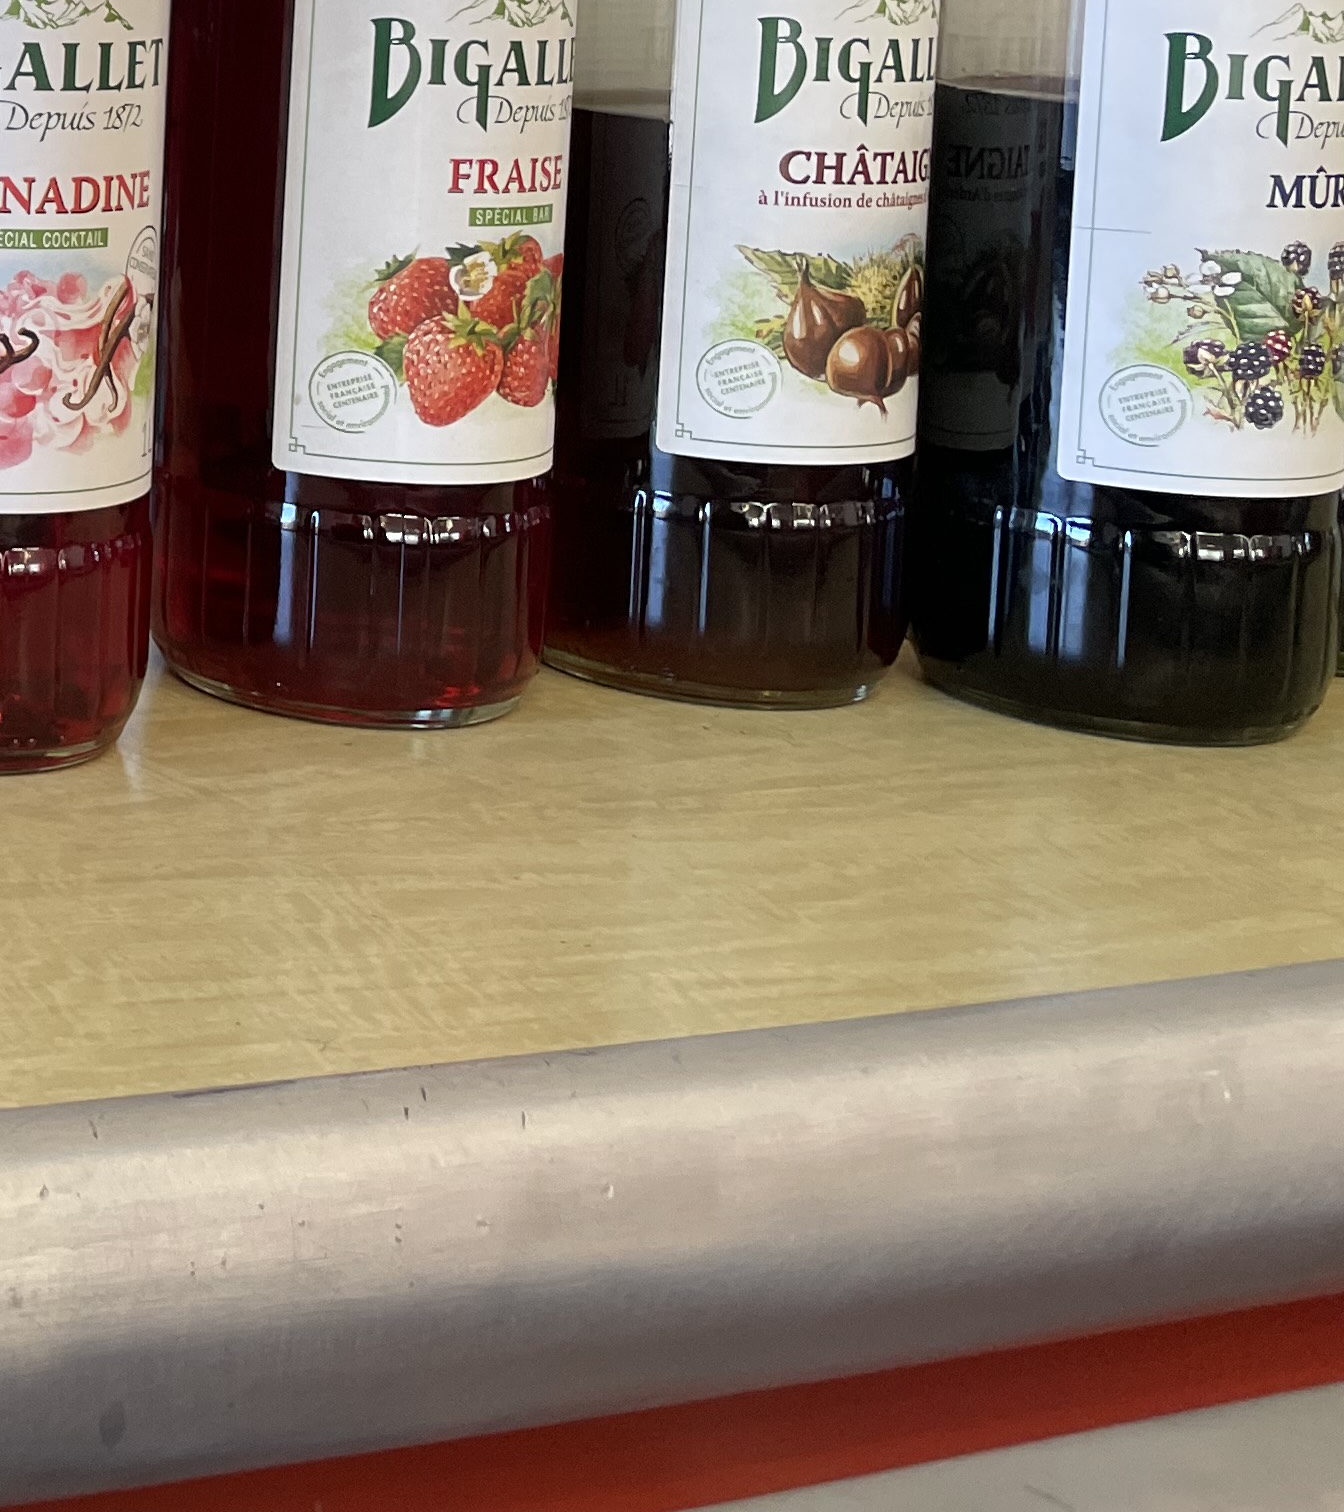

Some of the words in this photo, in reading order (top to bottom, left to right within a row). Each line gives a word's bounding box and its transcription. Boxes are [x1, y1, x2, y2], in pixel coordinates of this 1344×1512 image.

[367, 16, 575, 133] BIGALL
[754, 16, 936, 128] BIGALL
[1160, 31, 1344, 148] BIGA
[4, 100, 98, 143] Depuis
[102, 102, 144, 133] 1872
[493, 95, 555, 134] Depuis
[873, 90, 926, 129] Depuis
[1294, 110, 1344, 150] Depu
[447, 155, 563, 195] FRAISE
[778, 143, 930, 186] CHÂTAIG
[758, 189, 768, 206] à
[773, 190, 852, 209] l'infusion
[856, 192, 873, 209] de
[1265, 164, 1344, 210] MÛR
[475, 206, 529, 226] SPÉCIAL
[532, 206, 551, 224] BAR
[42, 229, 105, 248] COCKTAIL
